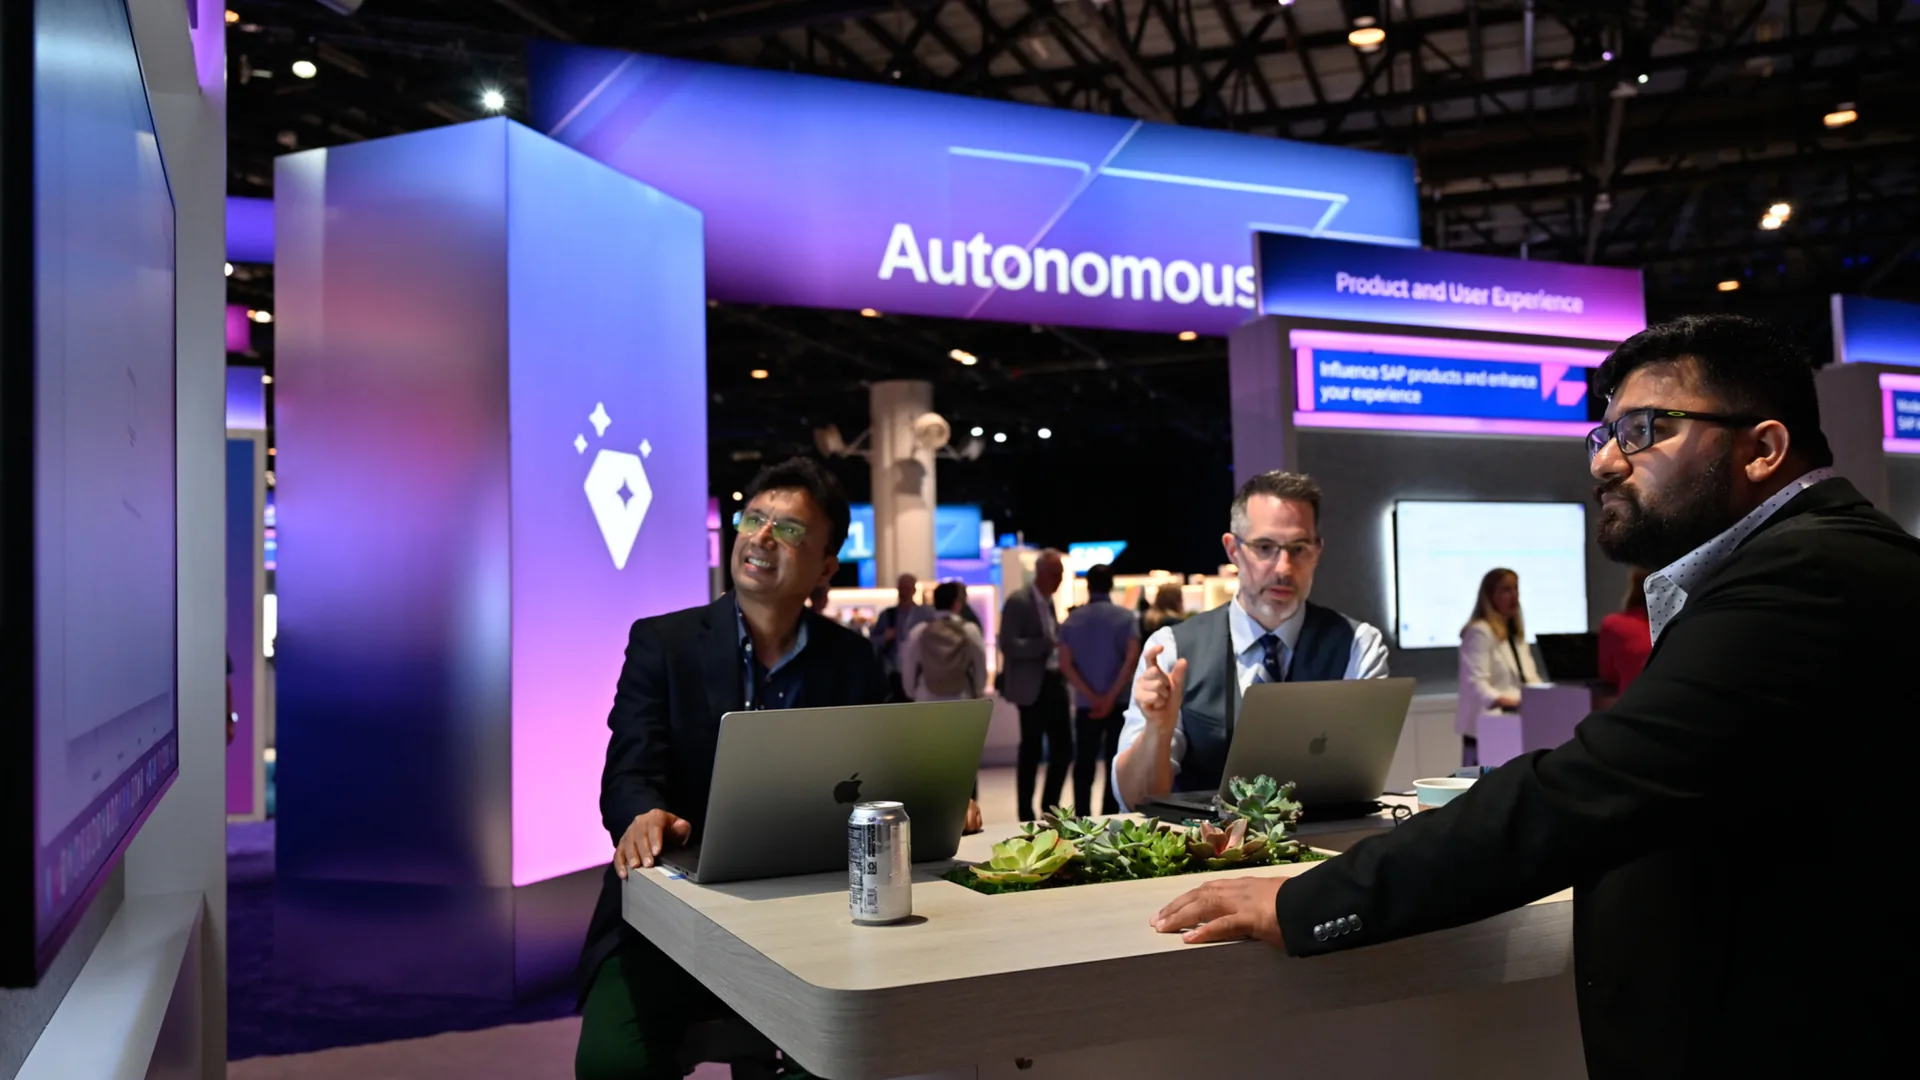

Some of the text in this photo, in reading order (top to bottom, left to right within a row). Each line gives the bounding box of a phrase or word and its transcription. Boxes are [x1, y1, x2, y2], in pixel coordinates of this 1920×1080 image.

[878, 222, 1257, 310] Autonomous
[1336, 272, 1584, 314] Product and User Experience
[1320, 360, 1538, 390] Influence SAP products and enhance
[1320, 385, 1423, 405] your experience
